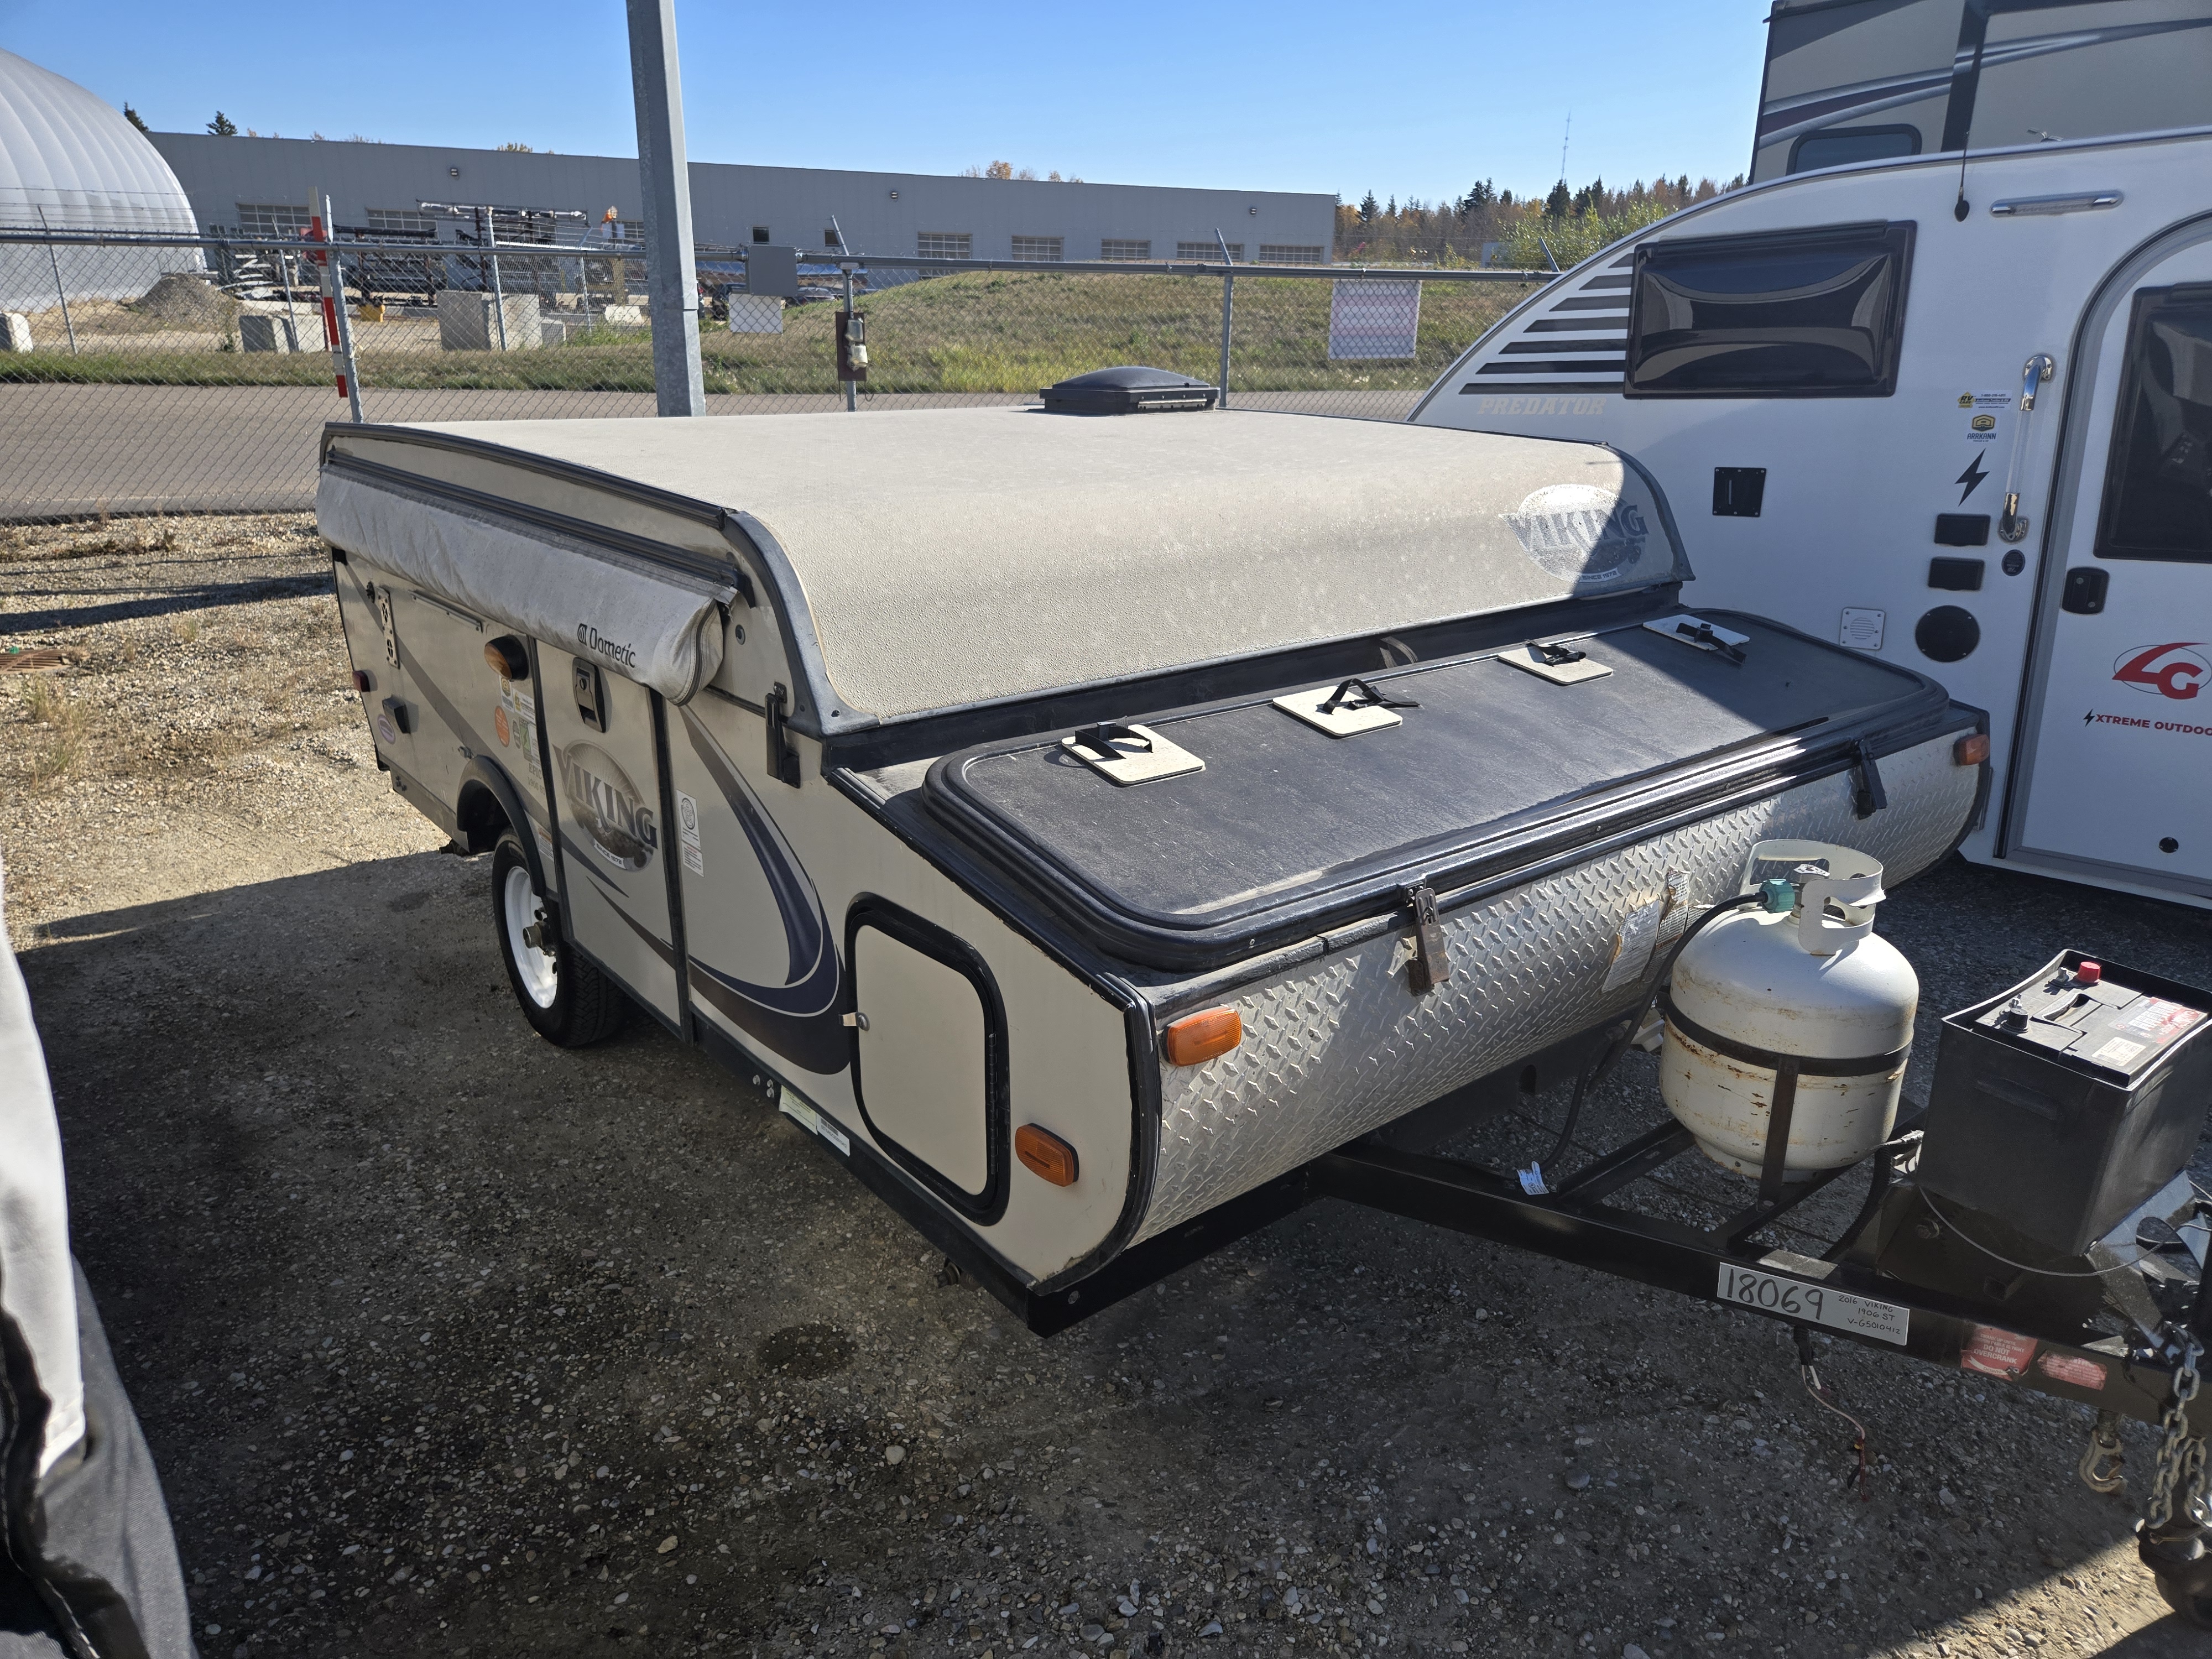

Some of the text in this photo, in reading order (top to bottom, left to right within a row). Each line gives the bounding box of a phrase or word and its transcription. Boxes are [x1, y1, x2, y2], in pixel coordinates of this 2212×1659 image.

[1477, 397, 1607, 415] PREDATOR
[1498, 505, 1649, 555] VIKING
[589, 627, 636, 669] Dometic
[2095, 713, 2151, 728] XTREME
[529, 763, 542, 780] EPIC
[552, 743, 658, 849] VIKING
[1727, 1268, 1823, 1321] 18069
[1838, 1295, 1893, 1313] 2016 VIKING
[1858, 1307, 1895, 1322] 1906 ST
[1974, 1348, 2017, 1364] OVERCRANK
[1995, 1347, 2010, 1355] NOT
